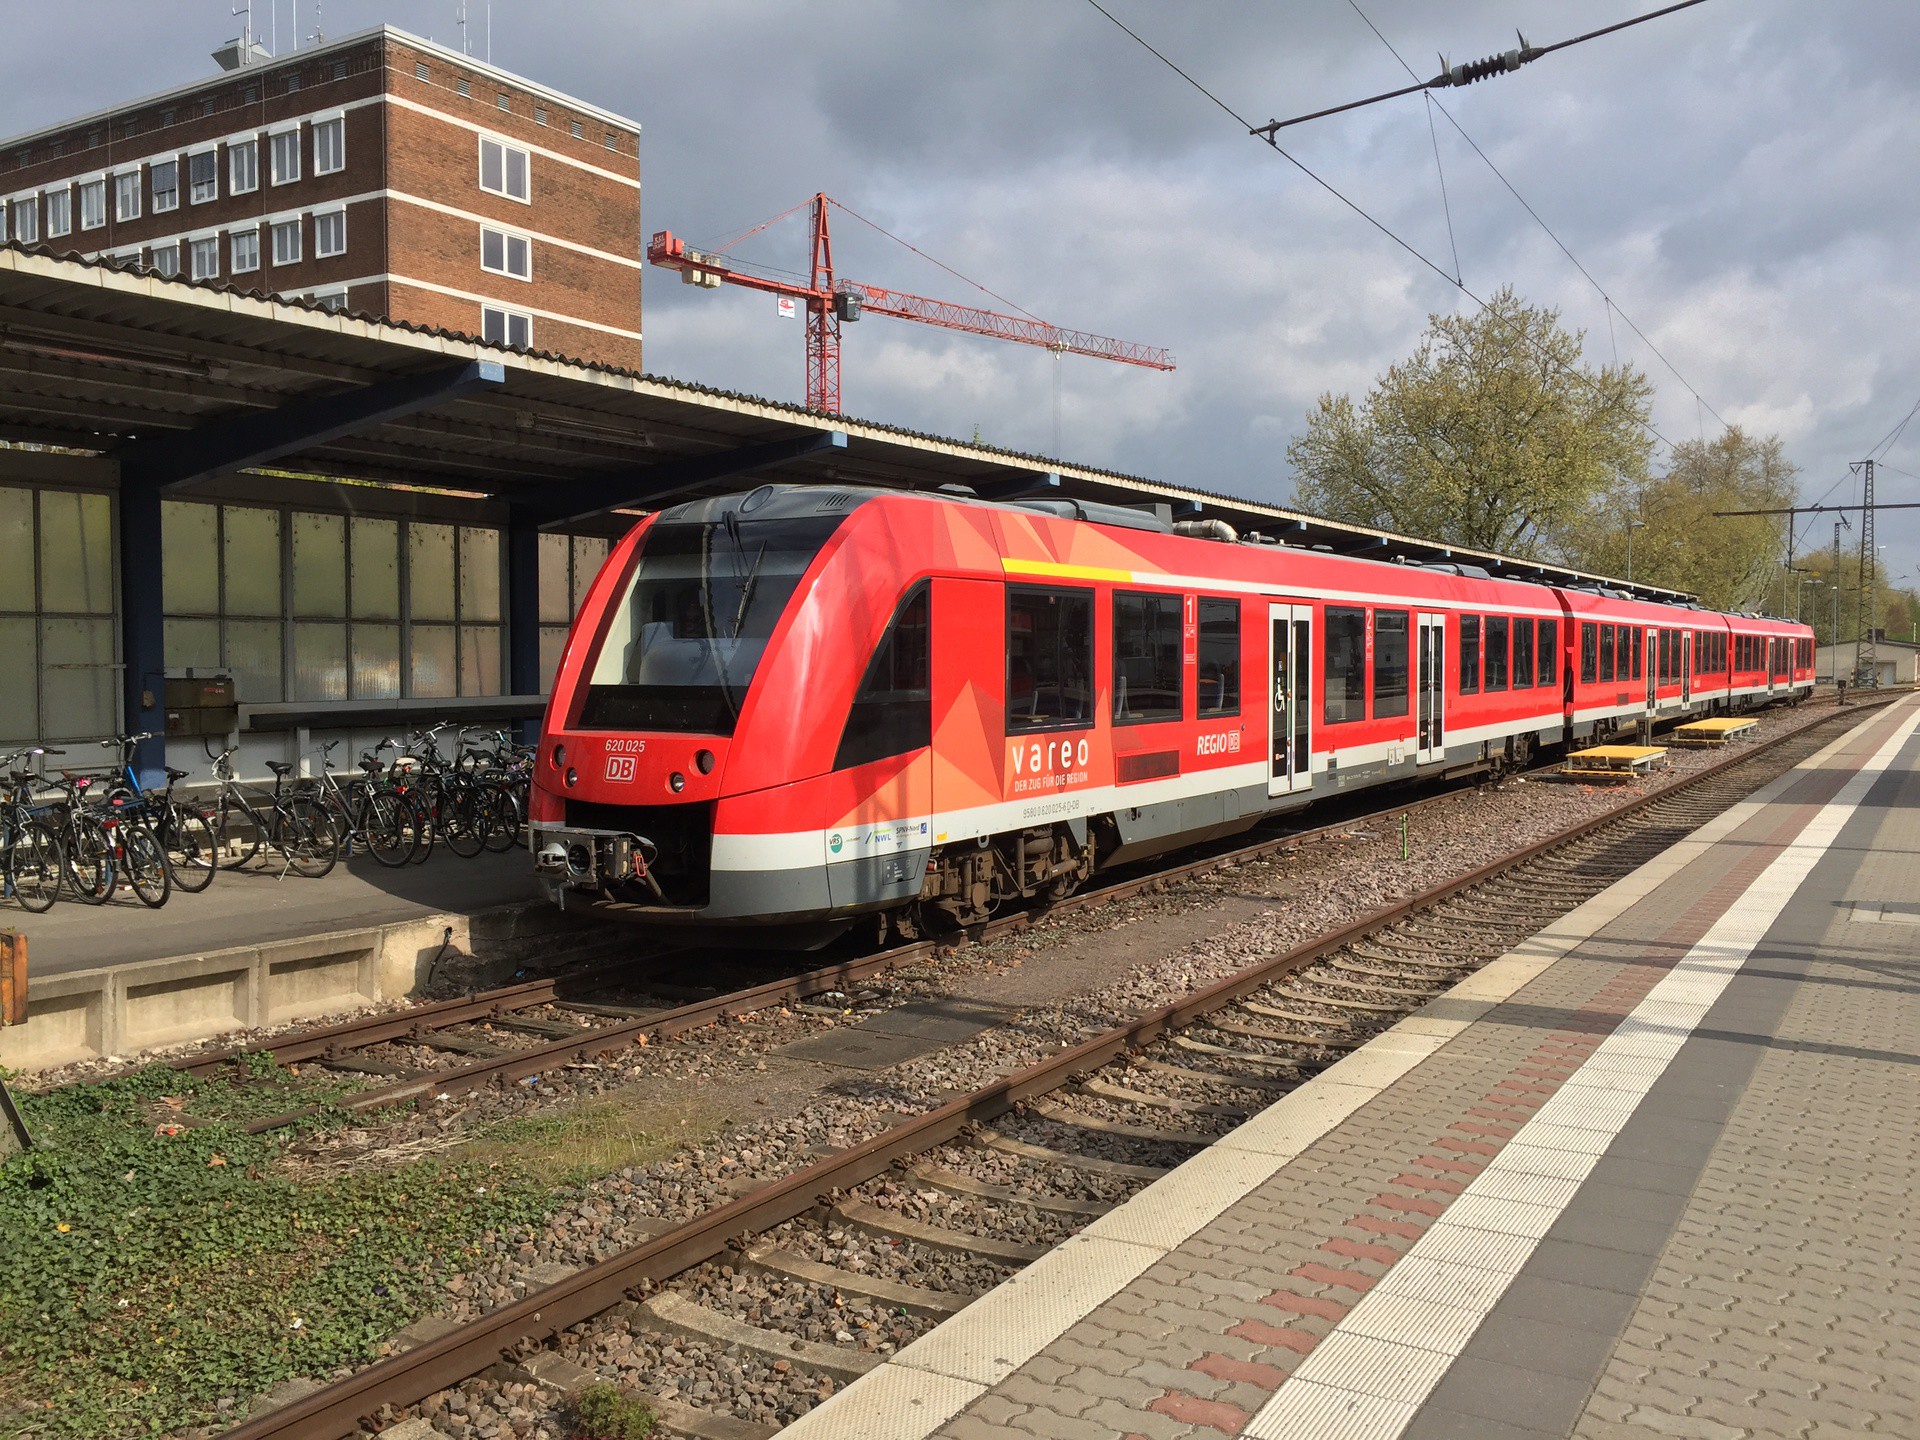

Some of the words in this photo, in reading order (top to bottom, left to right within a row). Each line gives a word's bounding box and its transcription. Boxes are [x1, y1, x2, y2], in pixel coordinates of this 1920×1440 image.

[1186, 597, 1192, 623] 1
[1367, 610, 1372, 629] 2
[605, 739, 625, 752] 620
[625, 740, 646, 753] 025
[1196, 733, 1227, 756] REGIO
[1229, 732, 1239, 751] DB
[1012, 739, 1089, 774] vareo
[607, 757, 634, 780] DB
[1014, 780, 1027, 792] DER
[1028, 777, 1041, 790] ZUG
[1042, 774, 1055, 788] FÜR
[1055, 774, 1065, 786] DIE
[1066, 772, 1088, 784] REGION
[875, 834, 891, 843] NWL
[896, 825, 919, 834] SPNV-Nord
